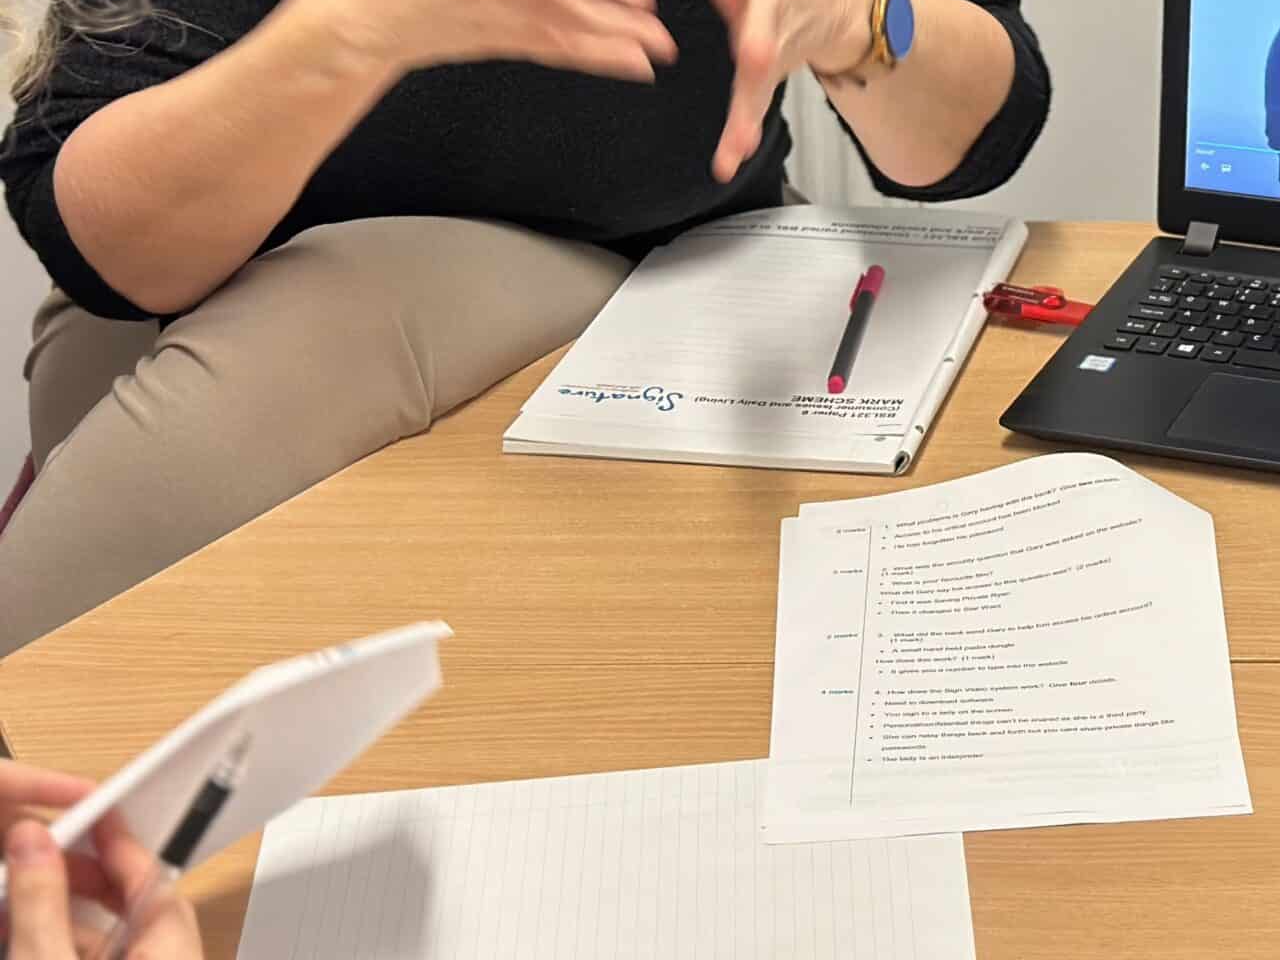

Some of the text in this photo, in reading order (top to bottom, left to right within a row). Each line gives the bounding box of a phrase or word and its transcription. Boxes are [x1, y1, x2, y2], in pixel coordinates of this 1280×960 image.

[558, 386, 683, 411] Signature
[738, 398, 767, 408] Daily
[792, 395, 904, 406] MARK SCHEME
[813, 410, 847, 418] Paper
